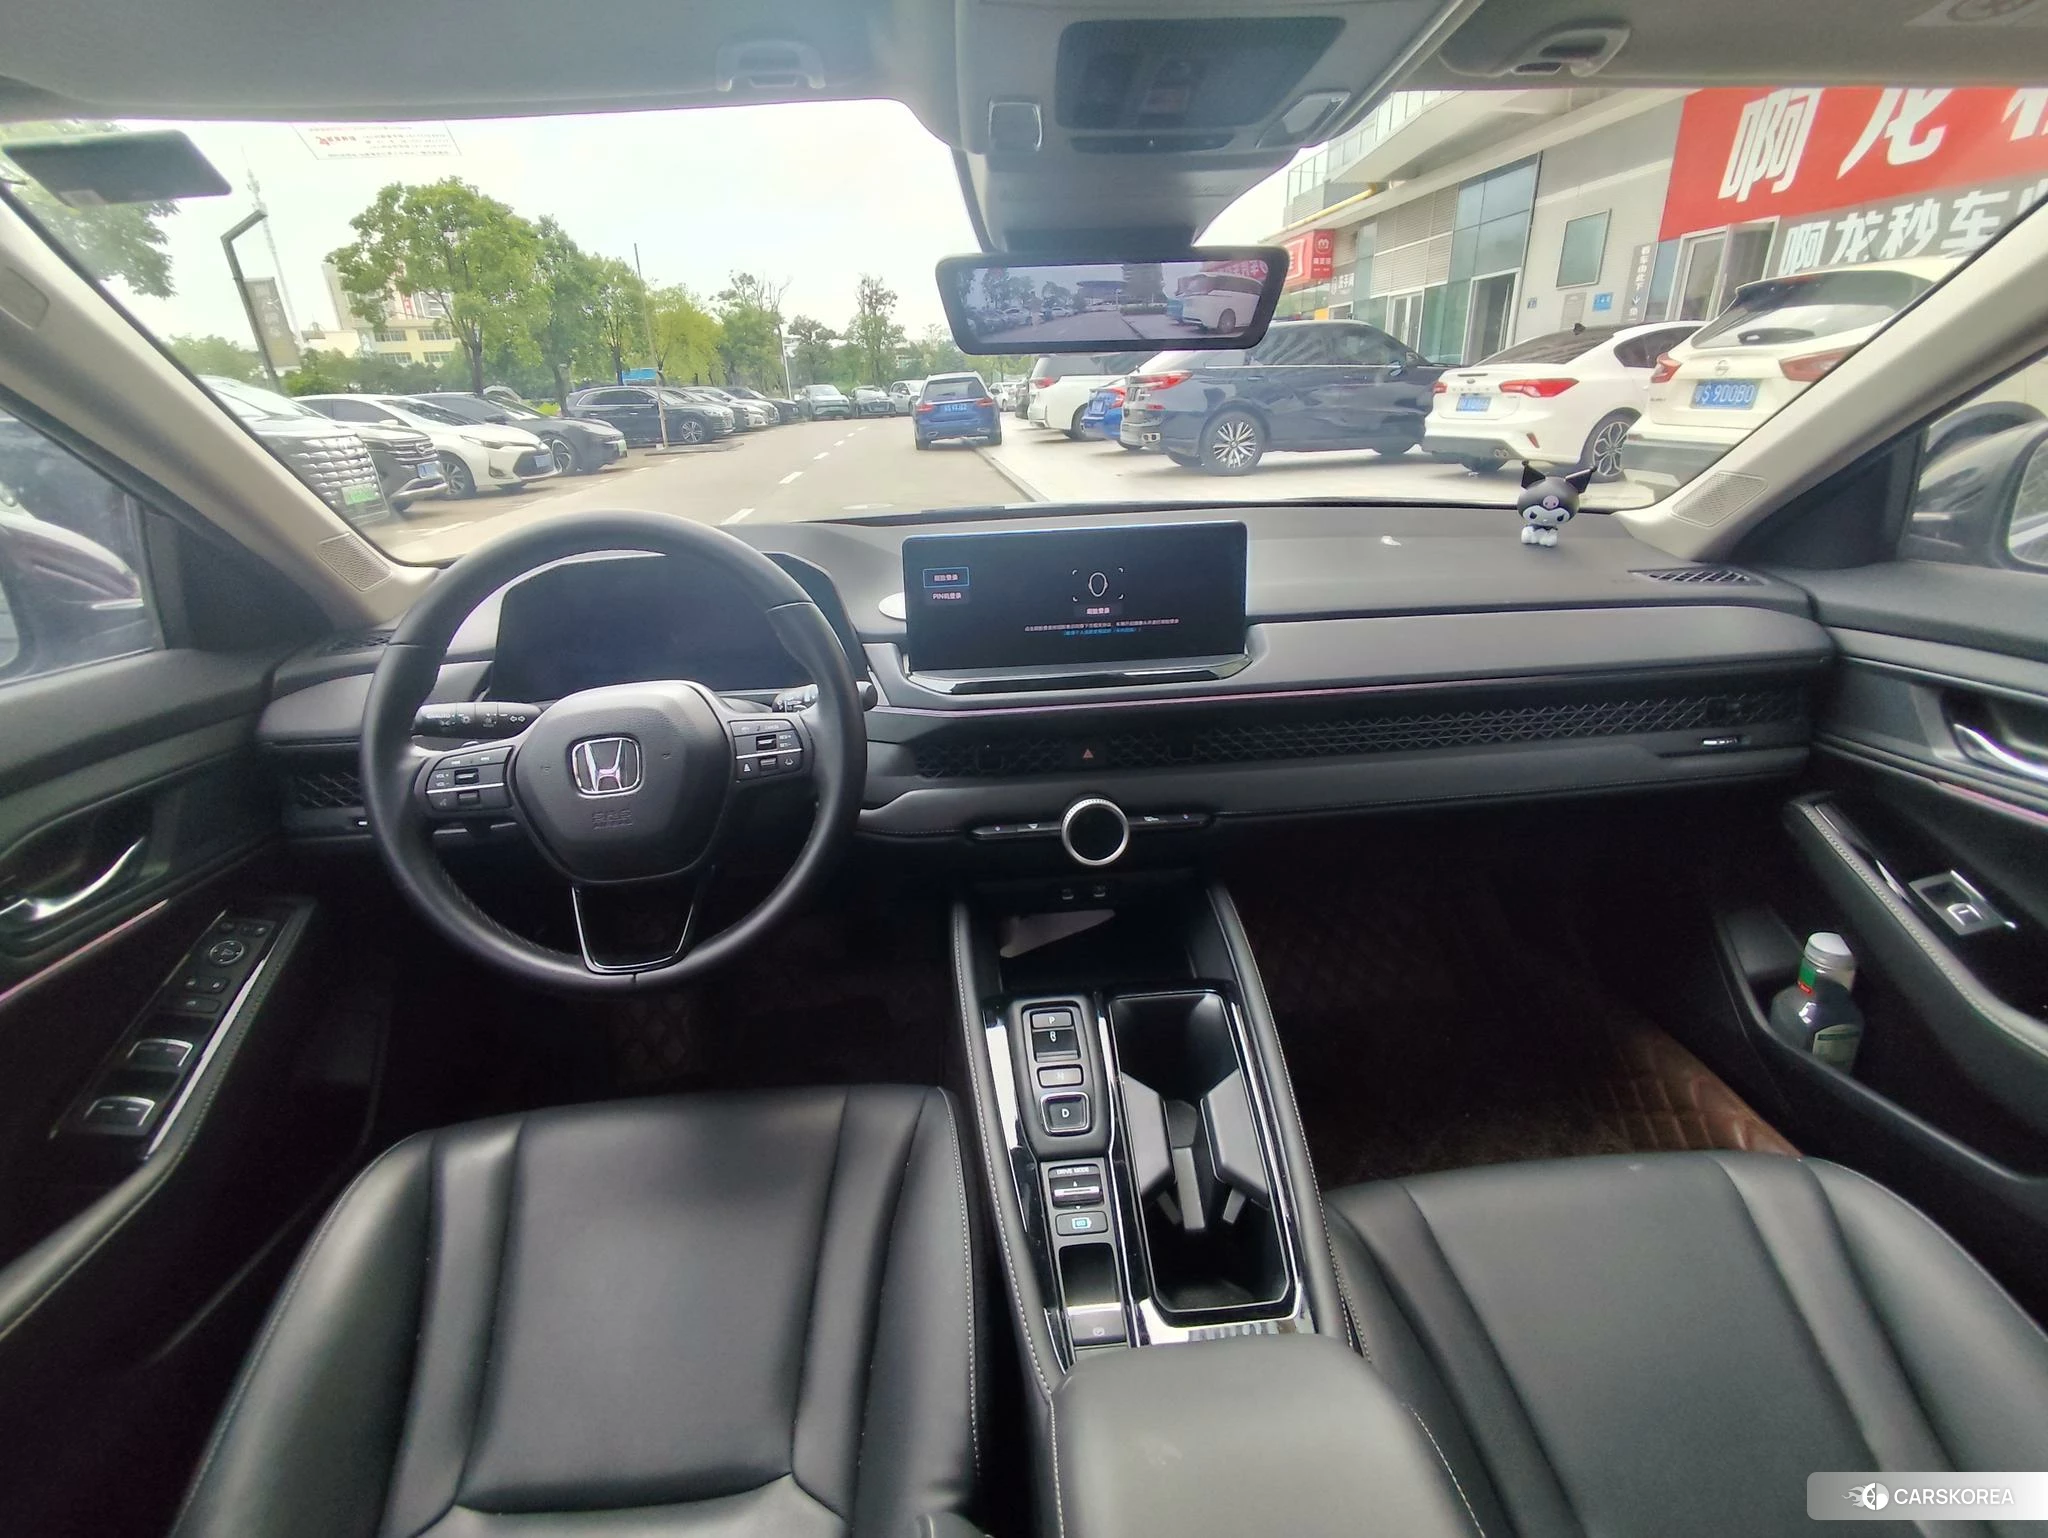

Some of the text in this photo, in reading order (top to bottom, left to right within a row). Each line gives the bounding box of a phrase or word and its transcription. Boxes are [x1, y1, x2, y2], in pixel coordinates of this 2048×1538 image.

[1717, 86, 2048, 203] 啊龙
[1048, 1016, 1055, 1024] P
[1061, 1108, 1070, 1118] D
